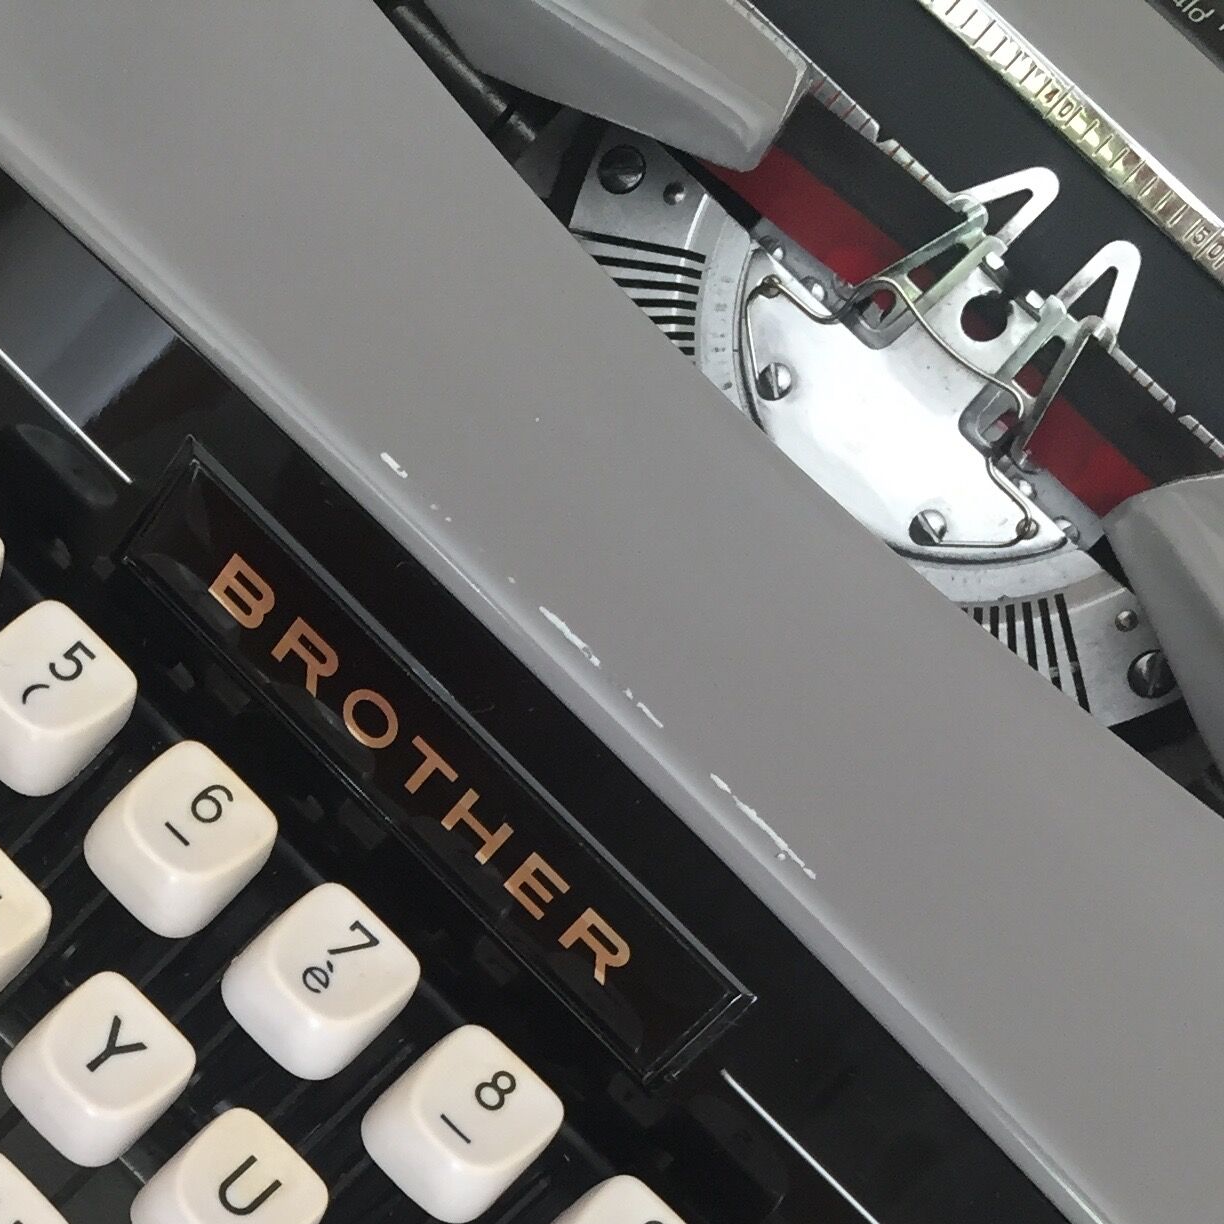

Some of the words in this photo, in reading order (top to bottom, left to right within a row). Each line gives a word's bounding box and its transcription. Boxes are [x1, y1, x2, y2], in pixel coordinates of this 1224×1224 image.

[49, 641, 96, 681] 5
[208, 553, 631, 986] BROTHER
[191, 785, 233, 823] 6
[327, 920, 380, 955] 7
[86, 1016, 147, 1072] Y
[475, 1071, 516, 1111] 8
[219, 1155, 282, 1215] U
